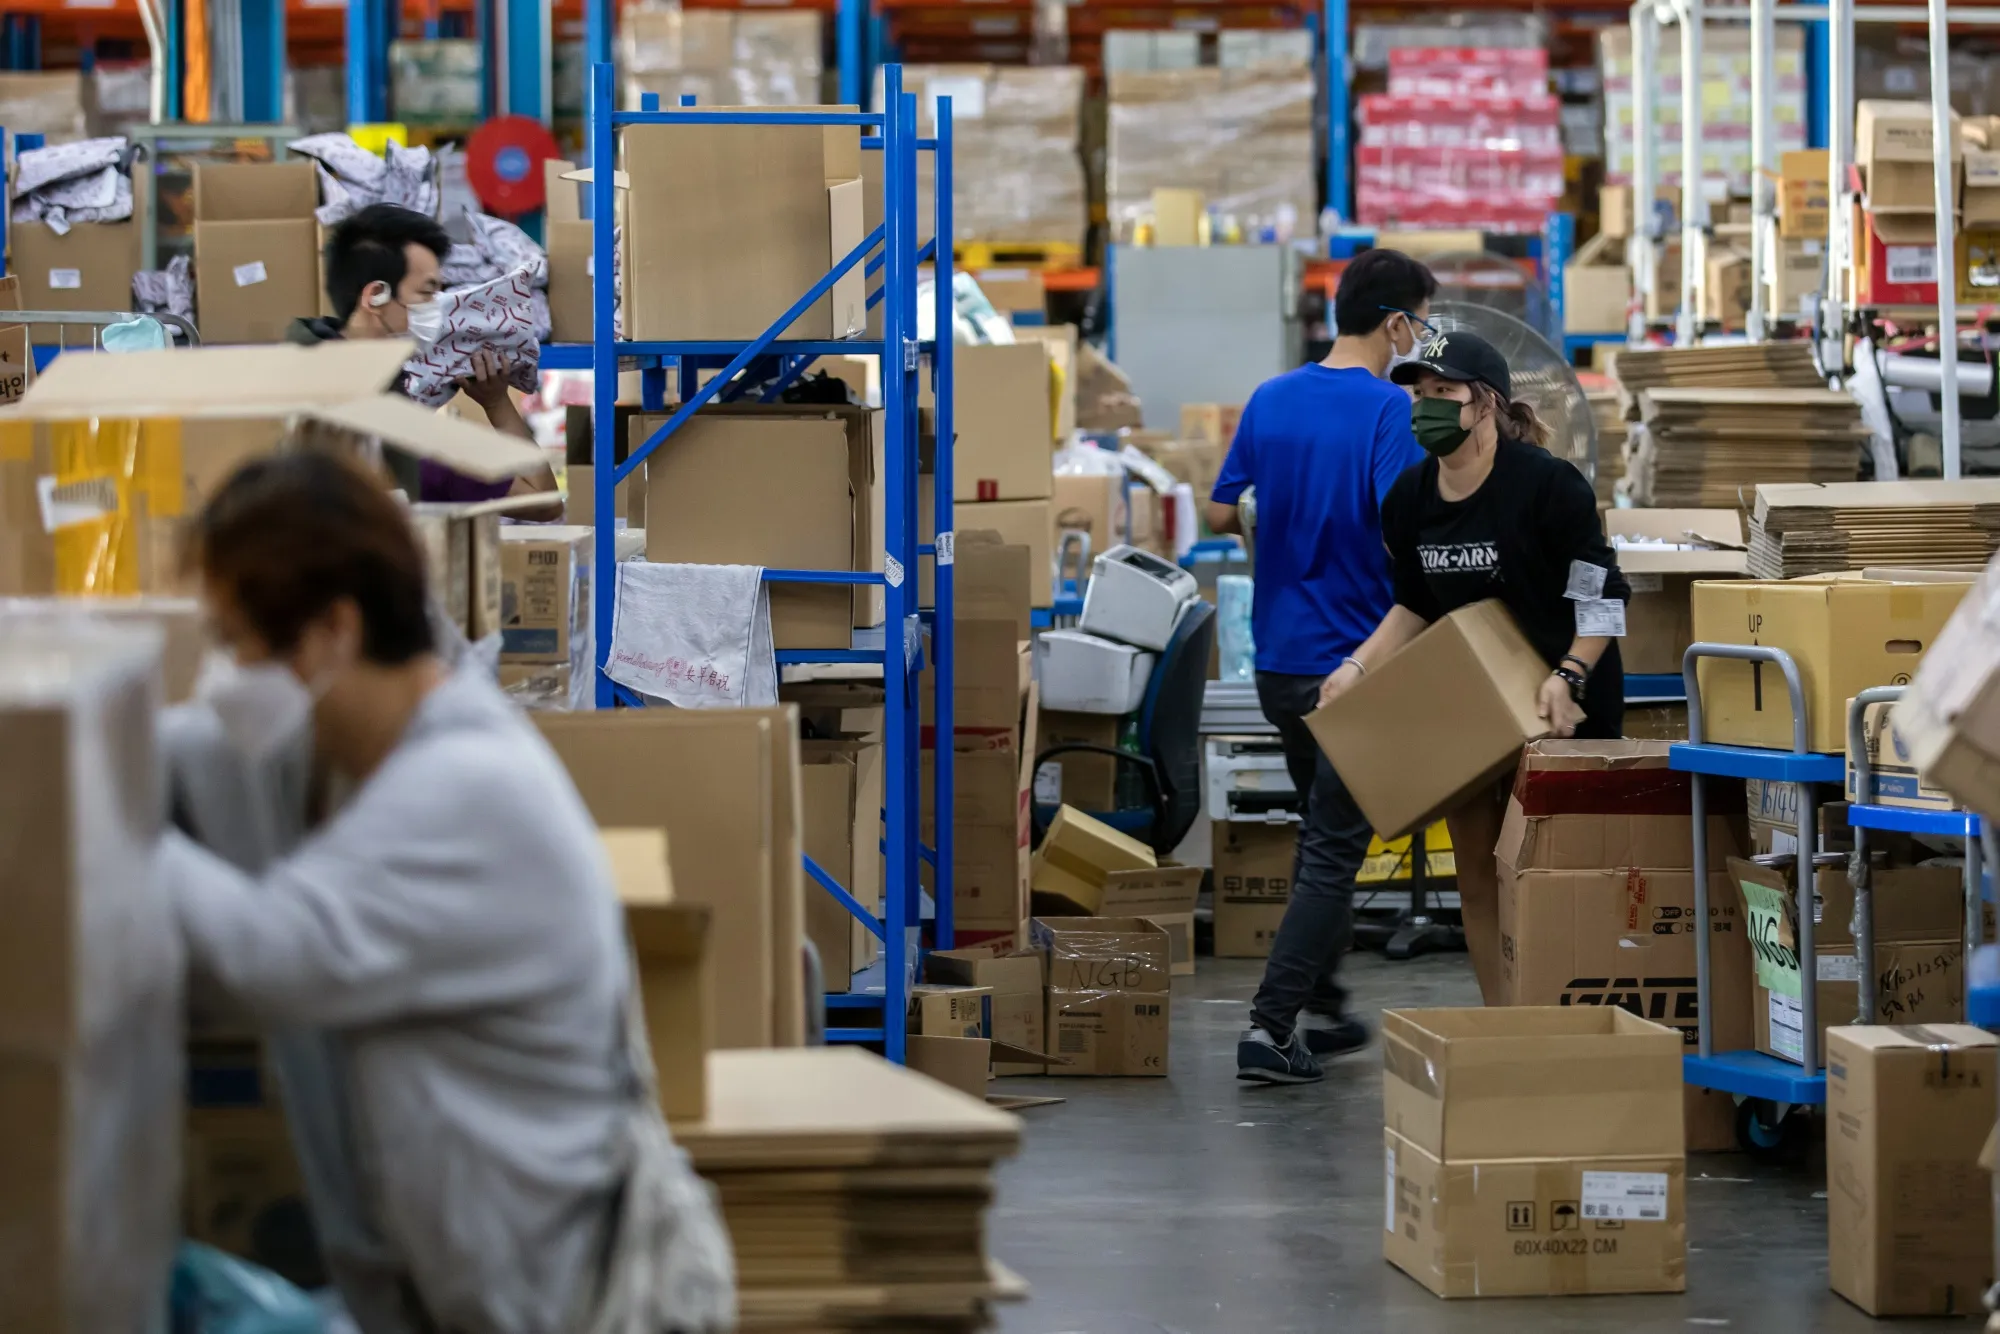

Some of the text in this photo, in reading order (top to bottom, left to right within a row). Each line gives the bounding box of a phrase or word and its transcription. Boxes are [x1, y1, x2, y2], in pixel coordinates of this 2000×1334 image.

[1748, 614, 1763, 633] UP
[1068, 957, 1142, 992] NGB
[1514, 1239, 1617, 1256] 60X40X22 CM
